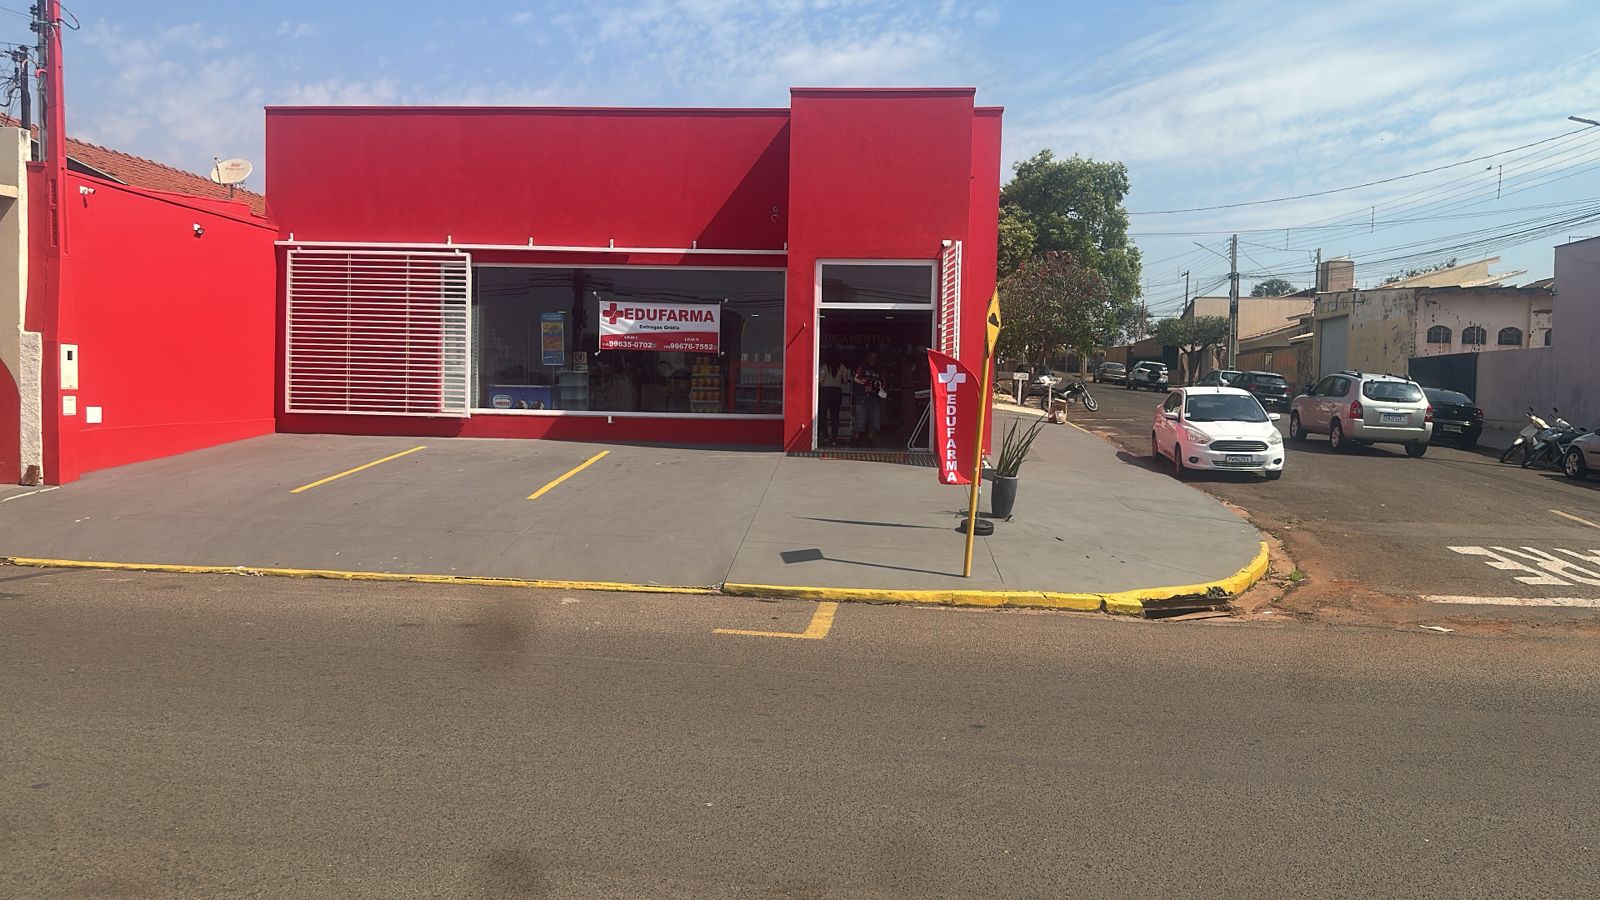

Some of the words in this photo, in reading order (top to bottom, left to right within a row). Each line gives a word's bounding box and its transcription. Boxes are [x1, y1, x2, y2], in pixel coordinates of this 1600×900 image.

[624, 307, 715, 323] EDUFARMA
[608, 340, 653, 349] 99635-0702
[670, 342, 714, 351] 99676-7552
[946, 394, 958, 482] EDUFARMA
